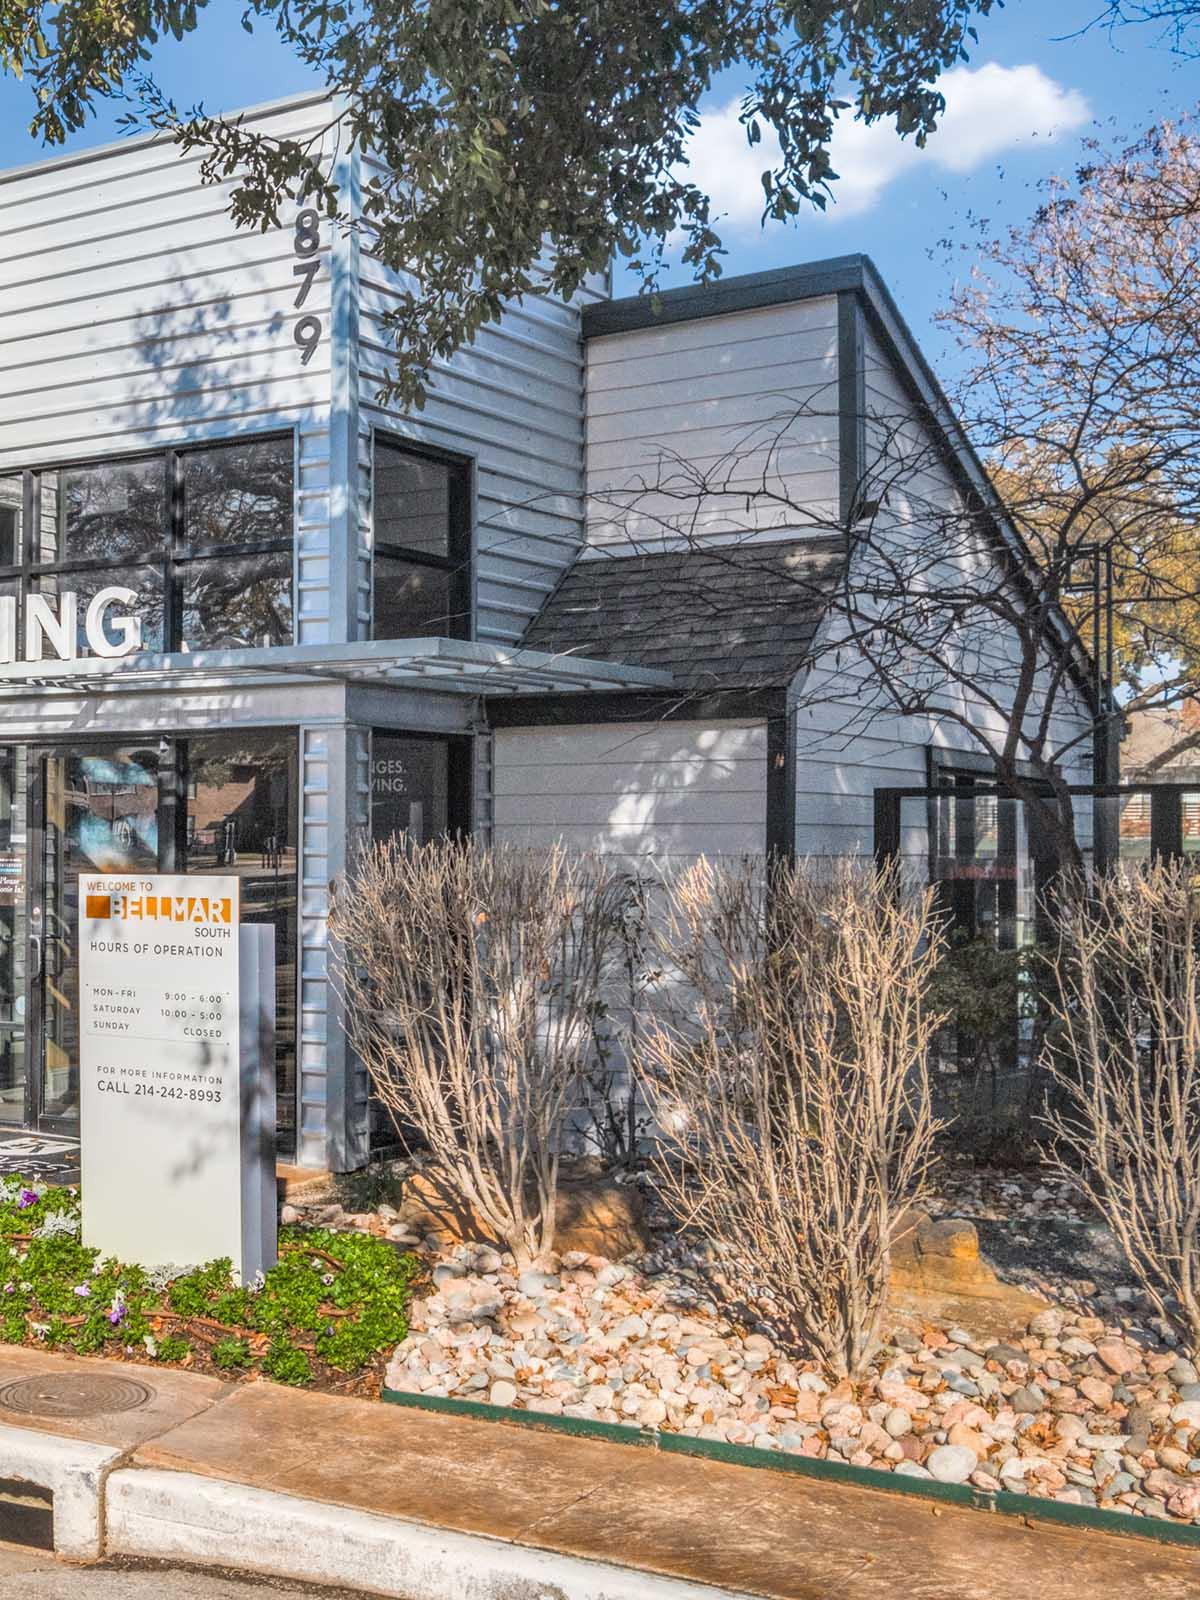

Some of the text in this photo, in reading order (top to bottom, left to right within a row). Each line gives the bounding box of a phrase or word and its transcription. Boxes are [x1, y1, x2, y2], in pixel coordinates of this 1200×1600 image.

[86, 881, 153, 892] WELCOME TO
[111, 896, 229, 923] BELLMAR
[194, 927, 232, 938] SOUTH
[90, 941, 224, 957] HOURS OF OPERATION
[164, 992, 187, 1001] 9:00
[199, 994, 222, 1004] 6:00
[93, 1004, 142, 1015] SATURDAY
[160, 1008, 187, 1018] 10:00
[199, 1011, 222, 1021] 5:00
[93, 1021, 222, 1038] SUNDAY CLOSED
[97, 1065, 222, 1085] FOR MORE INFORMATION
[97, 1080, 222, 1102] CALL 214-242-8993
